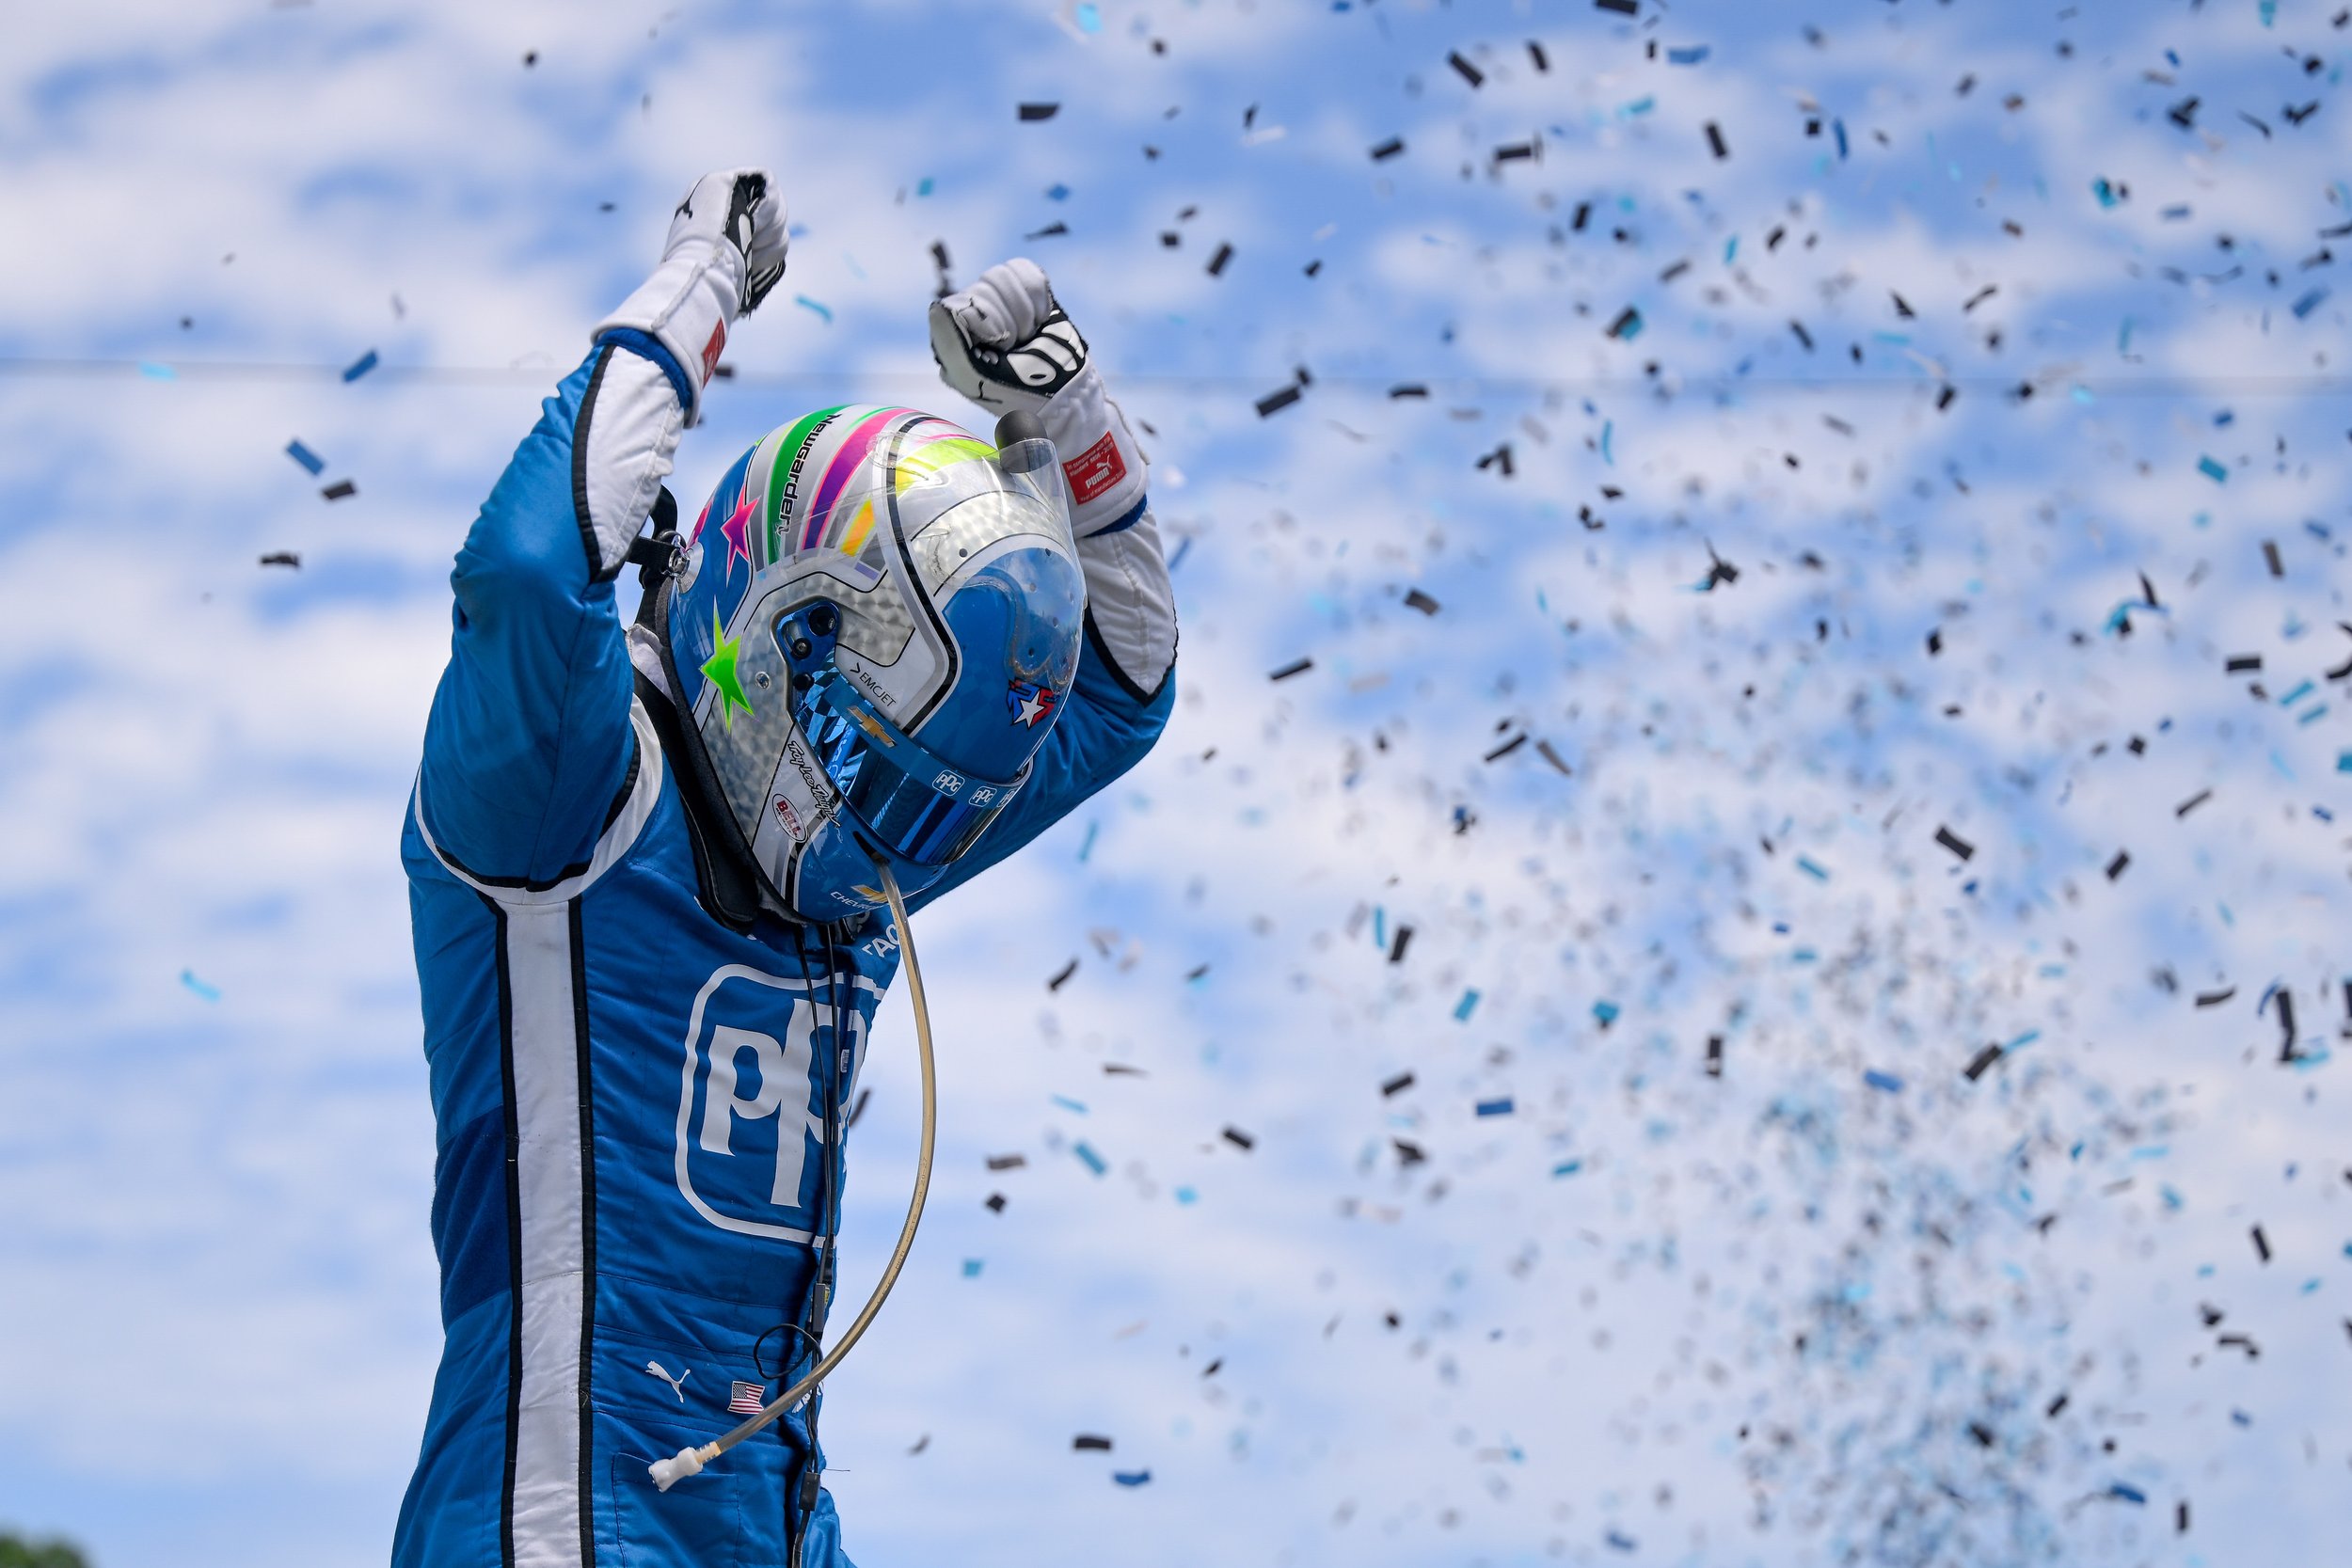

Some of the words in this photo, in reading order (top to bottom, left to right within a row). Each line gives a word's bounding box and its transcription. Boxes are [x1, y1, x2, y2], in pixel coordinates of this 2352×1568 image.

[1085, 467, 1109, 489] PUMA
[859, 672, 896, 707] EMCJET
[787, 740, 804, 765] Troy
[799, 766, 815, 788] Lee
[936, 774, 961, 792] PPG
[973, 789, 994, 803] PPG
[777, 800, 801, 836] BELL
